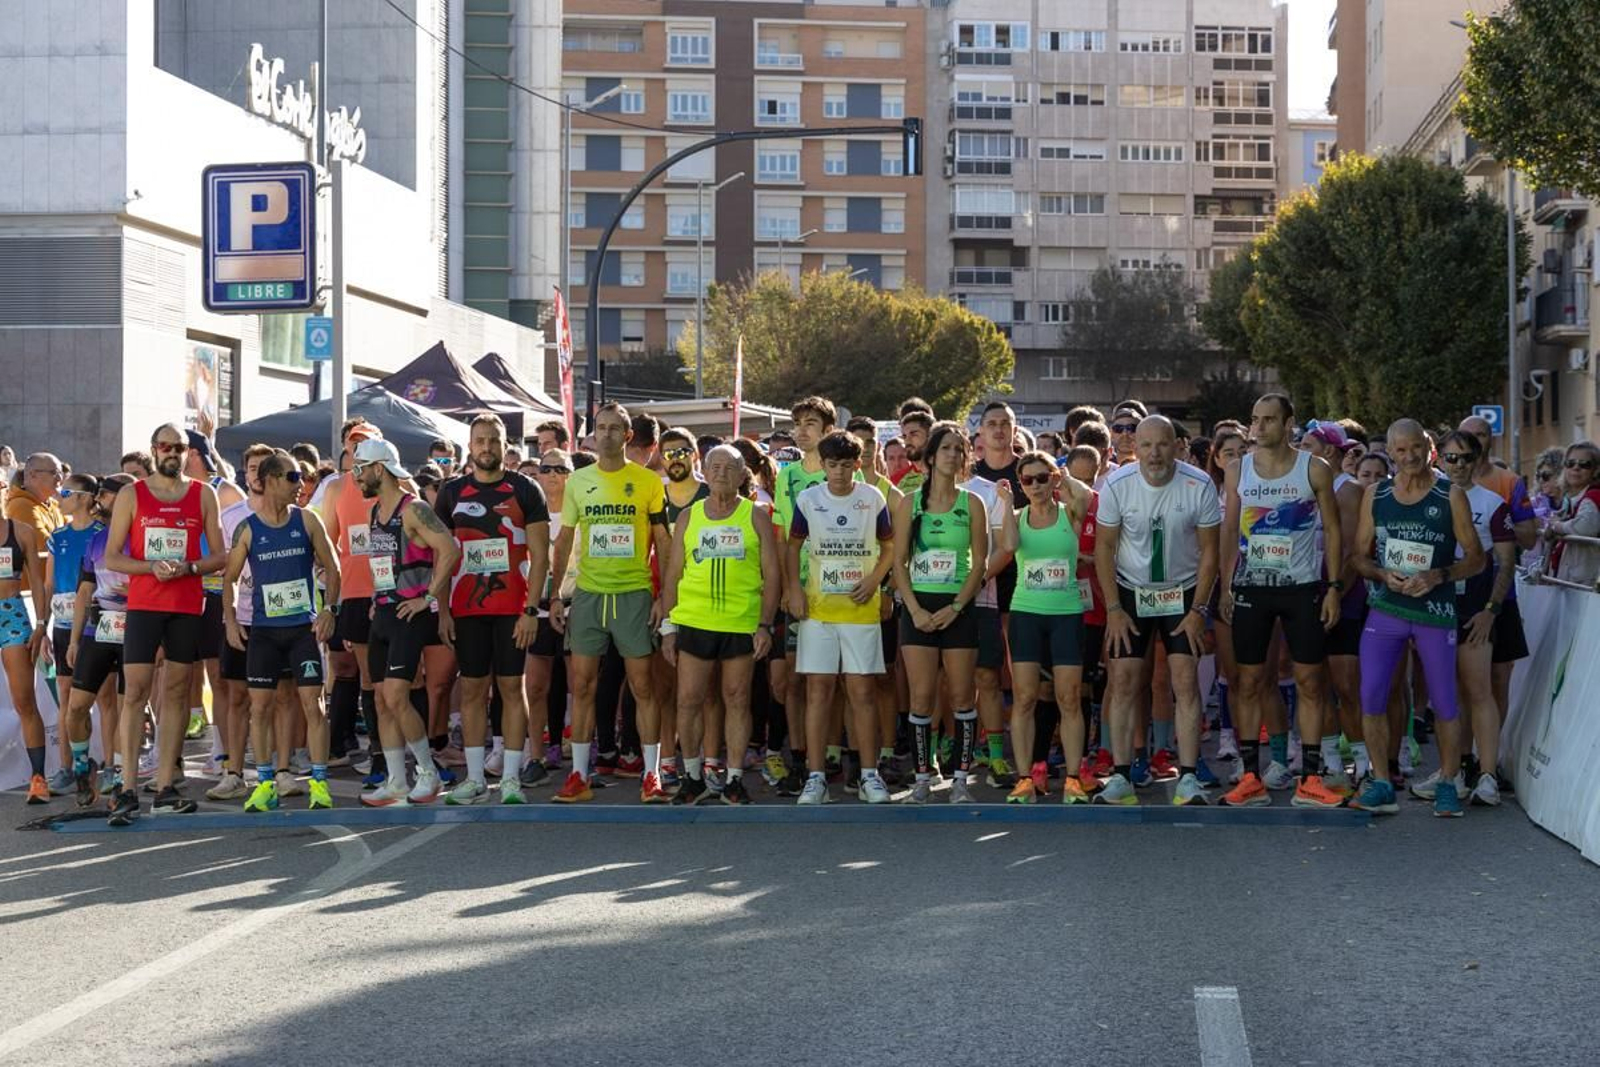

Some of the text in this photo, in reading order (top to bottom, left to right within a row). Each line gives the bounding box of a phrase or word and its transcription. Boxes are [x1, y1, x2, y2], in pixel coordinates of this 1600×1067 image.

[230, 181, 288, 250] P
[237, 284, 286, 298] LIBRE
[585, 504, 636, 516] PAMESA
[166, 539, 184, 547] 923
[611, 535, 630, 543] 874
[720, 535, 739, 543] 775
[485, 549, 504, 557] 860
[1266, 546, 1290, 555] 1061
[1406, 553, 1427, 564] 866
[933, 561, 952, 569] 977
[839, 570, 863, 579] 1098
[1047, 568, 1065, 577] 703
[289, 591, 302, 600] 36
[1156, 591, 1182, 602] 1002
